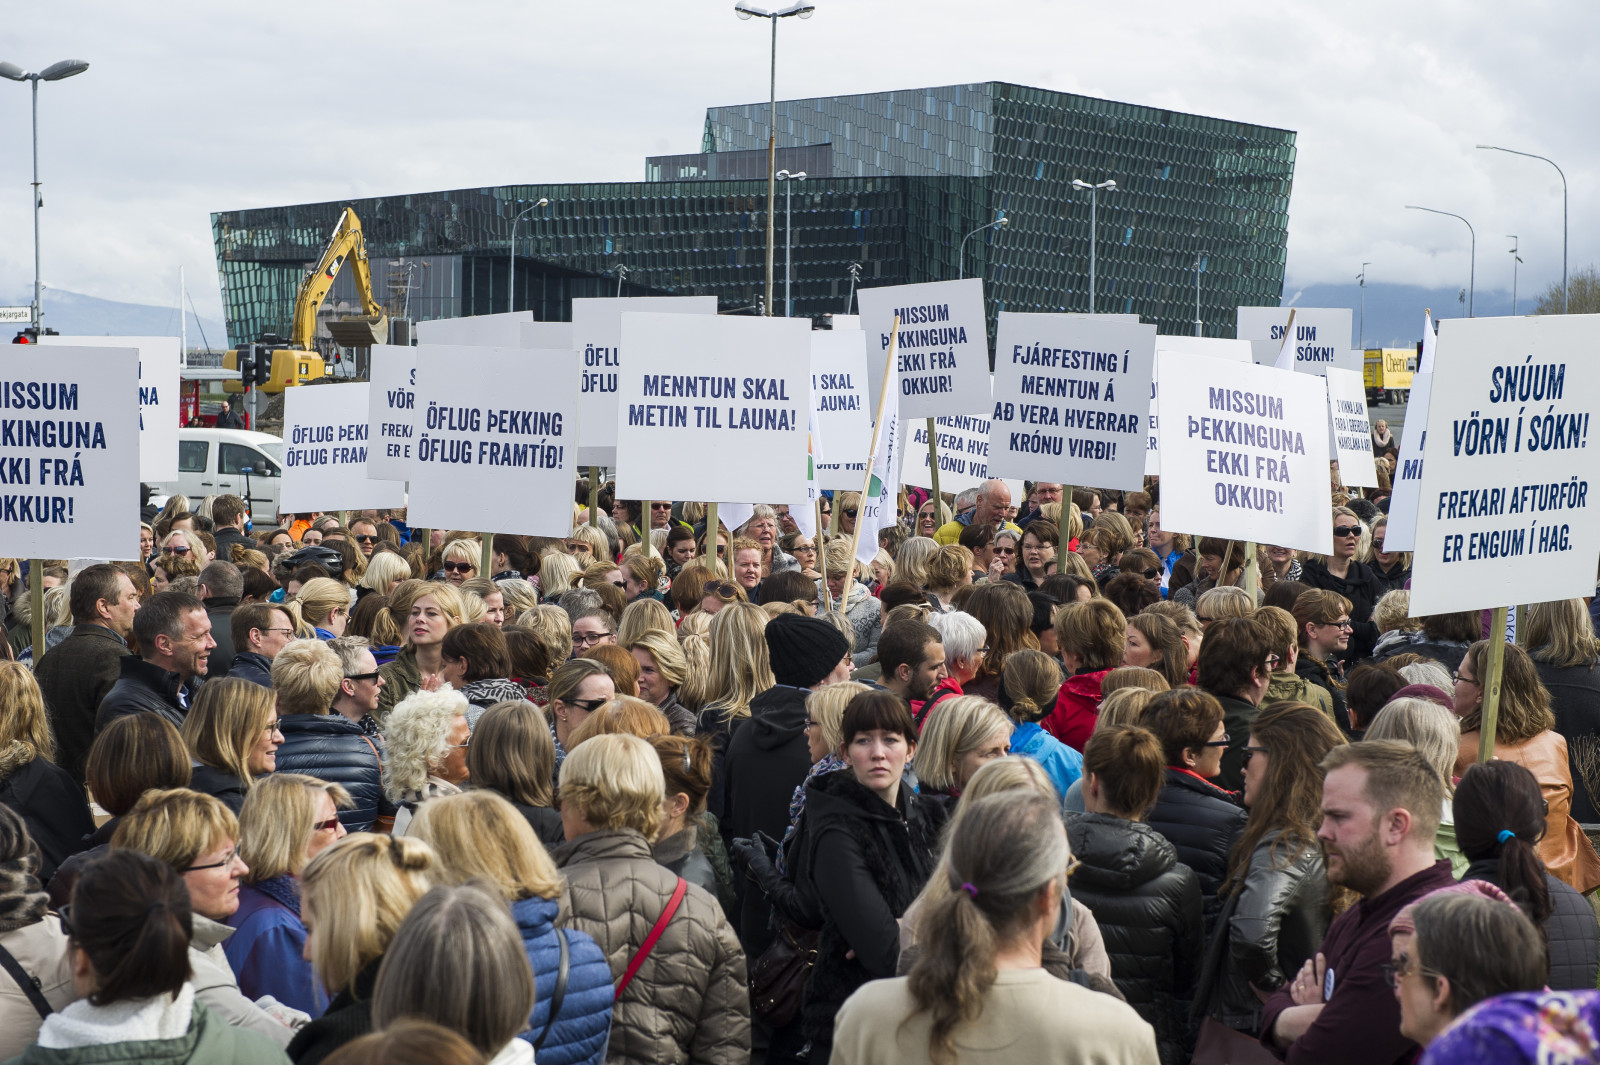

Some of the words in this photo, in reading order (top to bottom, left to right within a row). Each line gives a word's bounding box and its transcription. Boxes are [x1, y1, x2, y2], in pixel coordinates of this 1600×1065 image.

[893, 303, 950, 326] MISSUM
[880, 326, 968, 351] ÞKKINGUNA
[1270, 325, 1317, 342] SNUM
[929, 346, 957, 370] FRÁ
[1012, 341, 1118, 373] FJÁRFESTING
[1122, 349, 1131, 374] Í
[1296, 342, 1335, 362] SÓKN!
[325, 366, 334, 375] CAT
[820, 373, 855, 390] SKAL
[1489, 355, 1566, 403] SNÚUM
[0, 382, 78, 411] ISSUM
[387, 387, 415, 410] VÖR
[643, 374, 737, 399] MENNTUN
[742, 377, 790, 401] SKAL
[901, 375, 953, 396] OKKUR!
[1020, 374, 1100, 401] MENNTUN
[1103, 378, 1115, 403] Á
[816, 394, 861, 412] AUNA!
[992, 401, 1015, 422] AÐ
[1019, 403, 1060, 427] VERA
[1064, 408, 1140, 434] HVERRAR
[1208, 386, 1284, 421] MISSUM
[426, 401, 481, 432] ÖFLUG
[487, 409, 563, 437] ÞEKKING
[628, 404, 688, 428] METIN
[693, 406, 722, 429] TIL
[728, 407, 796, 432] LAUNA!
[1453, 410, 1510, 457] VÖRN
[1514, 406, 1526, 453] Í
[1527, 405, 1590, 452] SÓKN!
[0, 419, 107, 449] KINGUNA
[292, 424, 334, 445] ÖFLUG
[934, 432, 964, 452] VERA
[1009, 430, 1064, 456] KRÓNU
[1068, 437, 1118, 462] VIRÐI!
[1187, 415, 1306, 456] ÞEKKINGUNA
[286, 447, 328, 468] ÖFLUG
[386, 443, 400, 458] ER
[418, 433, 472, 464] ÖFLUG
[478, 438, 564, 470] FRAMTÍÐ!
[40, 451, 85, 487] FRÁ
[1206, 449, 1249, 477] EKKI
[1255, 454, 1291, 484] FRÁ
[0, 494, 74, 524] KKUR!
[1214, 482, 1284, 515] OKKUR!
[1437, 487, 1506, 520] FREKARI
[1508, 475, 1588, 515] AFTURFÖR
[1442, 534, 1464, 563] ER
[1468, 528, 1525, 561] ENGUM
[1528, 519, 1537, 555] Í
[1538, 523, 1573, 554] HAG.
